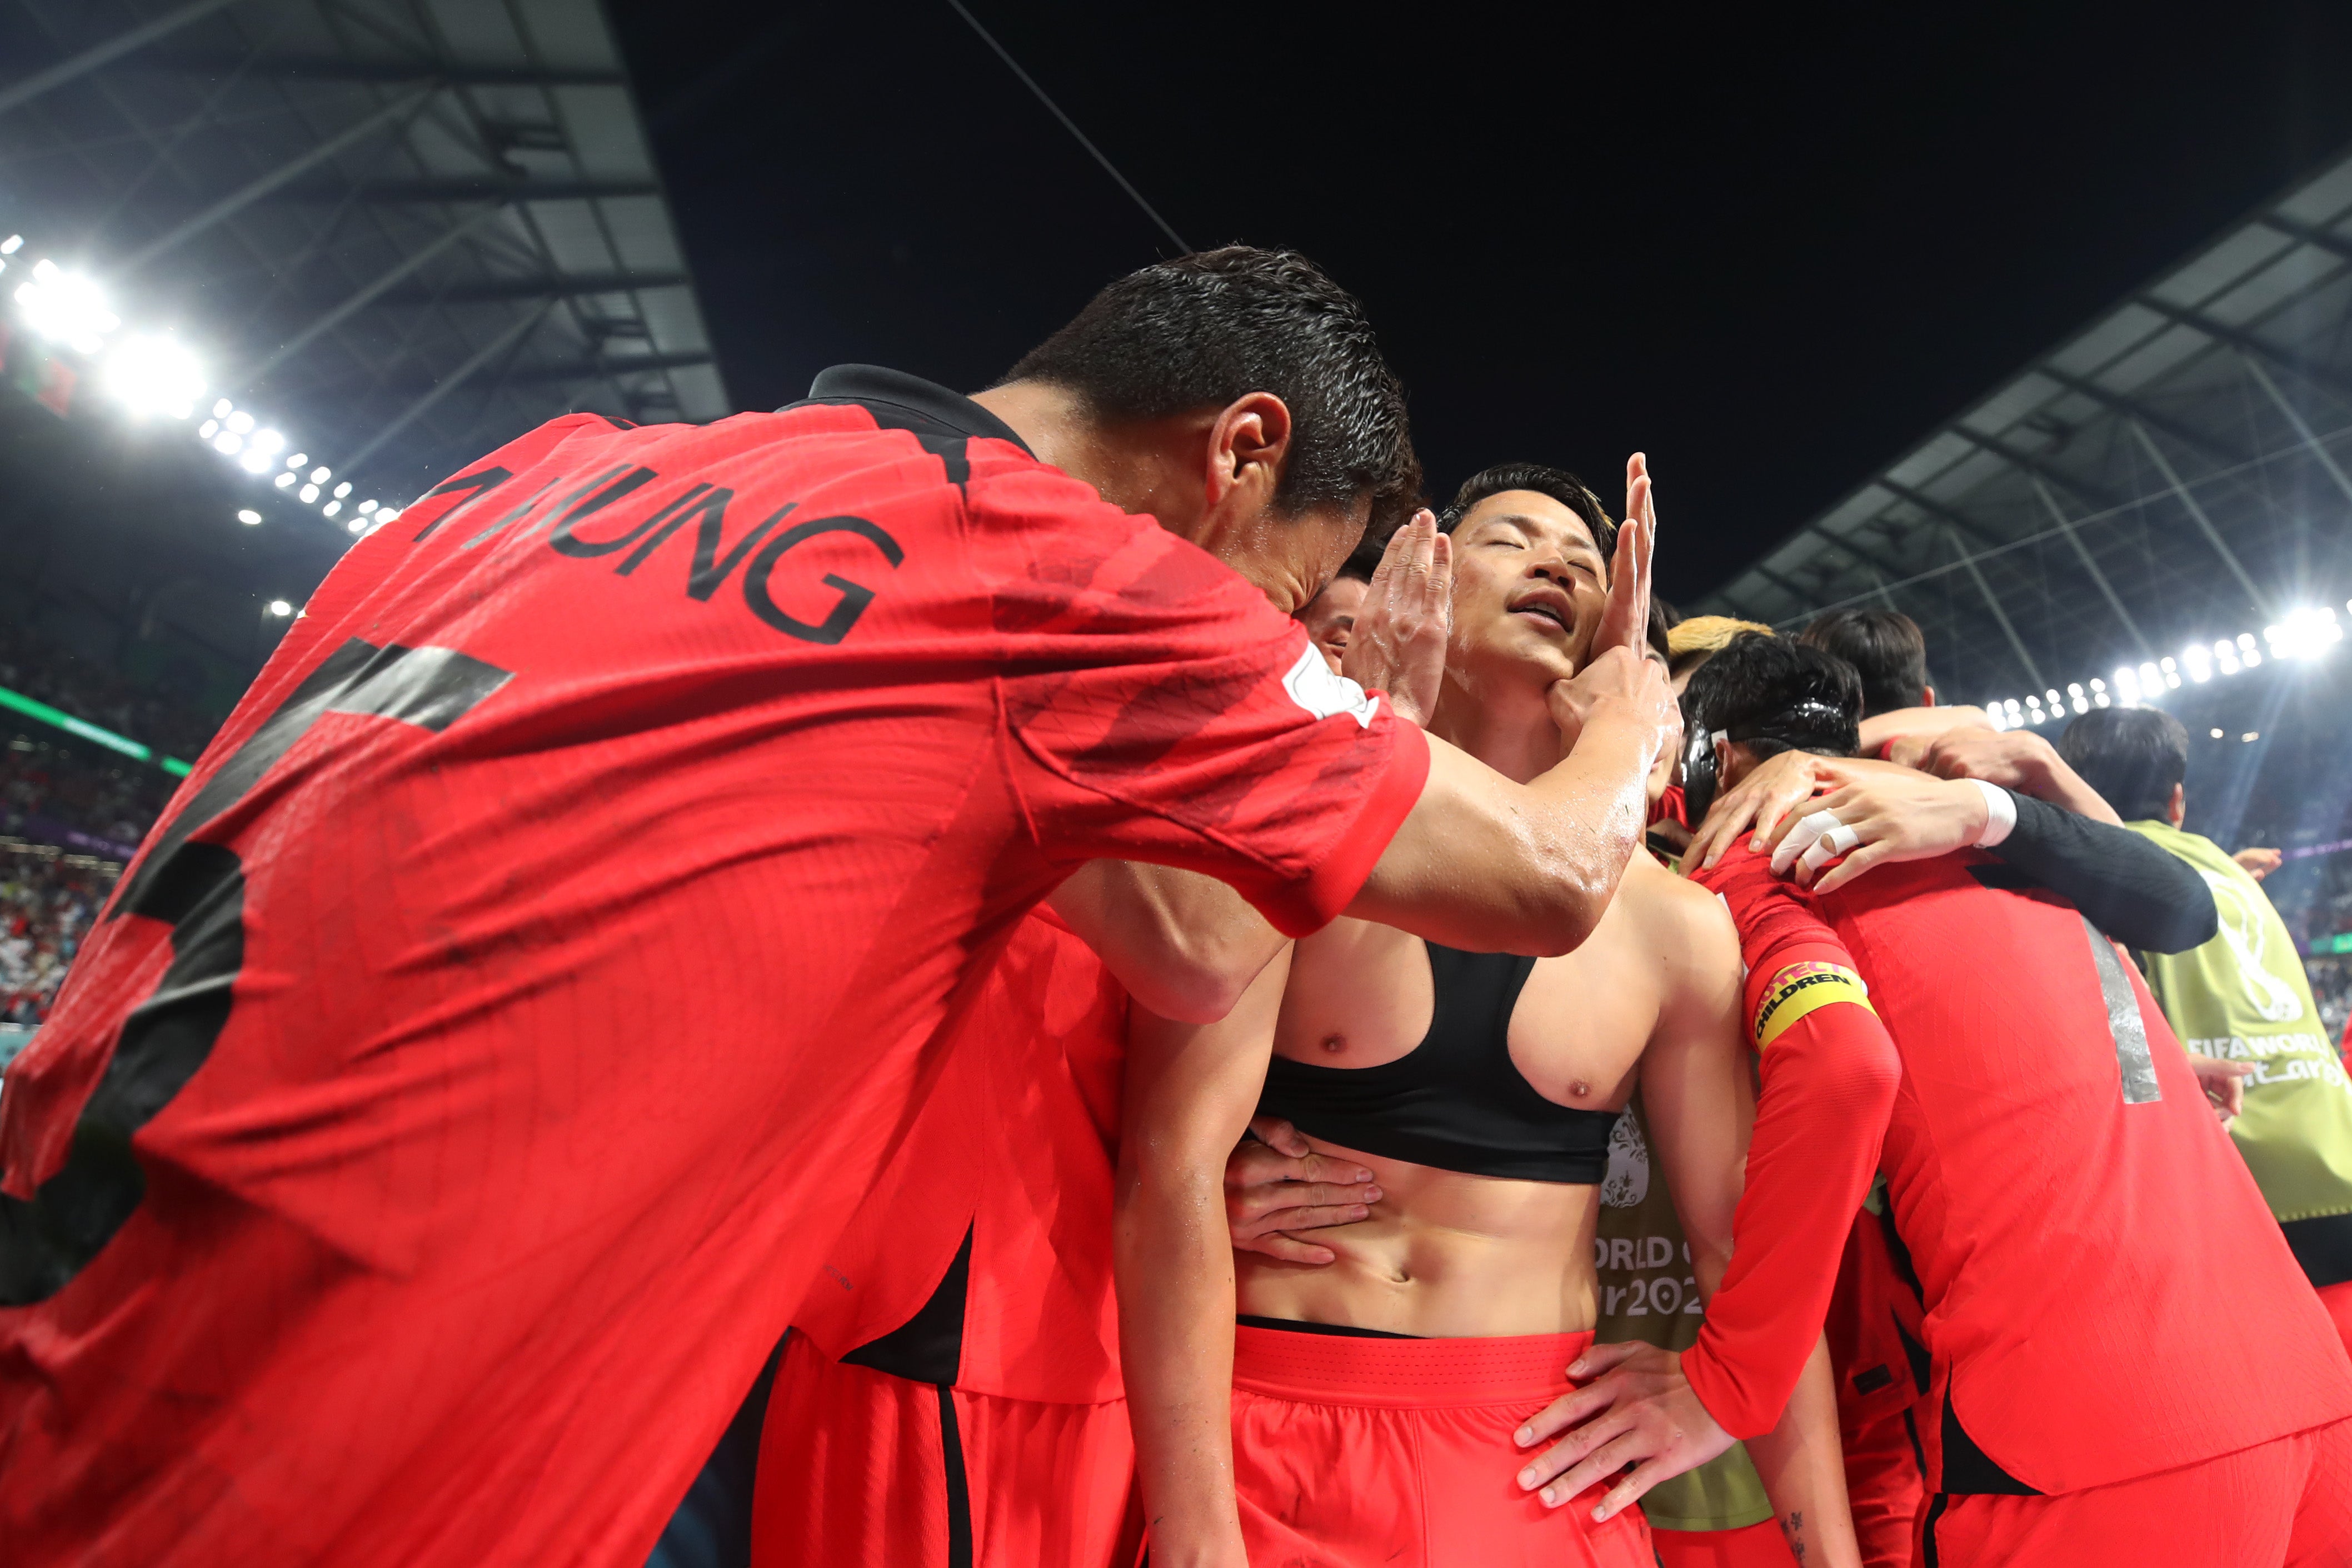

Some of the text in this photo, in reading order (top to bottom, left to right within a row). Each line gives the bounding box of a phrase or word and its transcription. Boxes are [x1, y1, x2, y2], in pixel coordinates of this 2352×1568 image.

[1756, 974, 1852, 1040] CHILDREN
[2188, 1036, 2250, 1059] FIFA
[1599, 1277, 1704, 1316] r202
